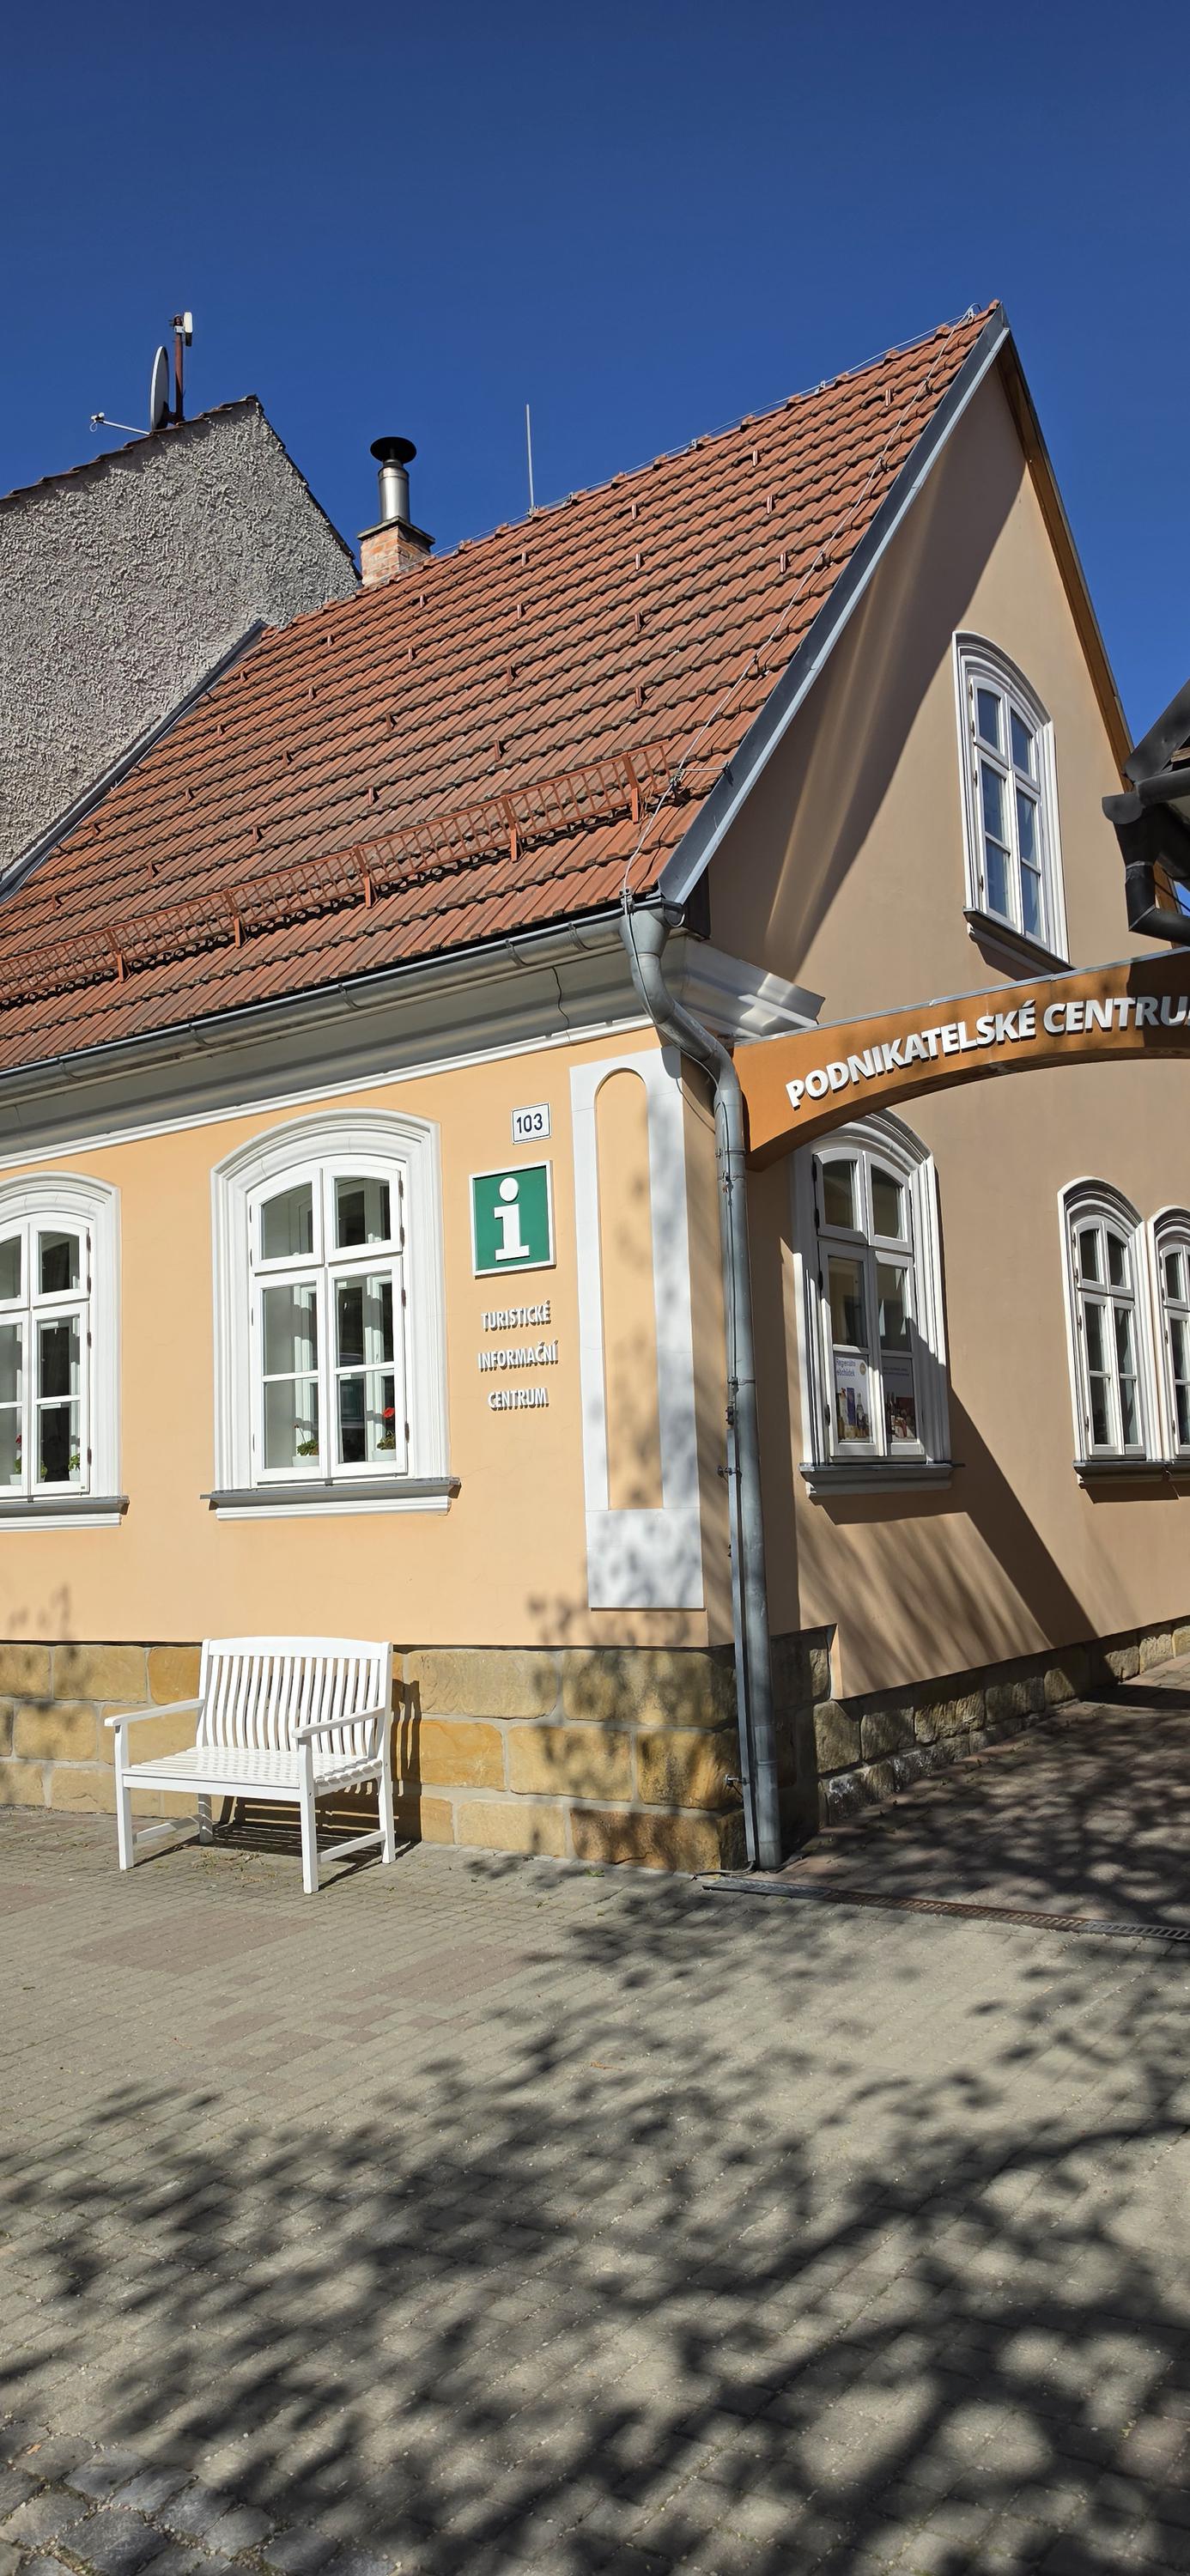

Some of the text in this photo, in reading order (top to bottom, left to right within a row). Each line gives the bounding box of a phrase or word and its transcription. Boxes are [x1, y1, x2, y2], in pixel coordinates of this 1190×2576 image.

[785, 996, 1190, 1108] PODNIKATELSKÉ CENTRU
[516, 1113, 543, 1133] 103
[481, 1300, 550, 1329] TURISTICKÉ
[478, 1340, 558, 1370] INFORMAČNÍ
[488, 1388, 548, 1409] CENTRUM
